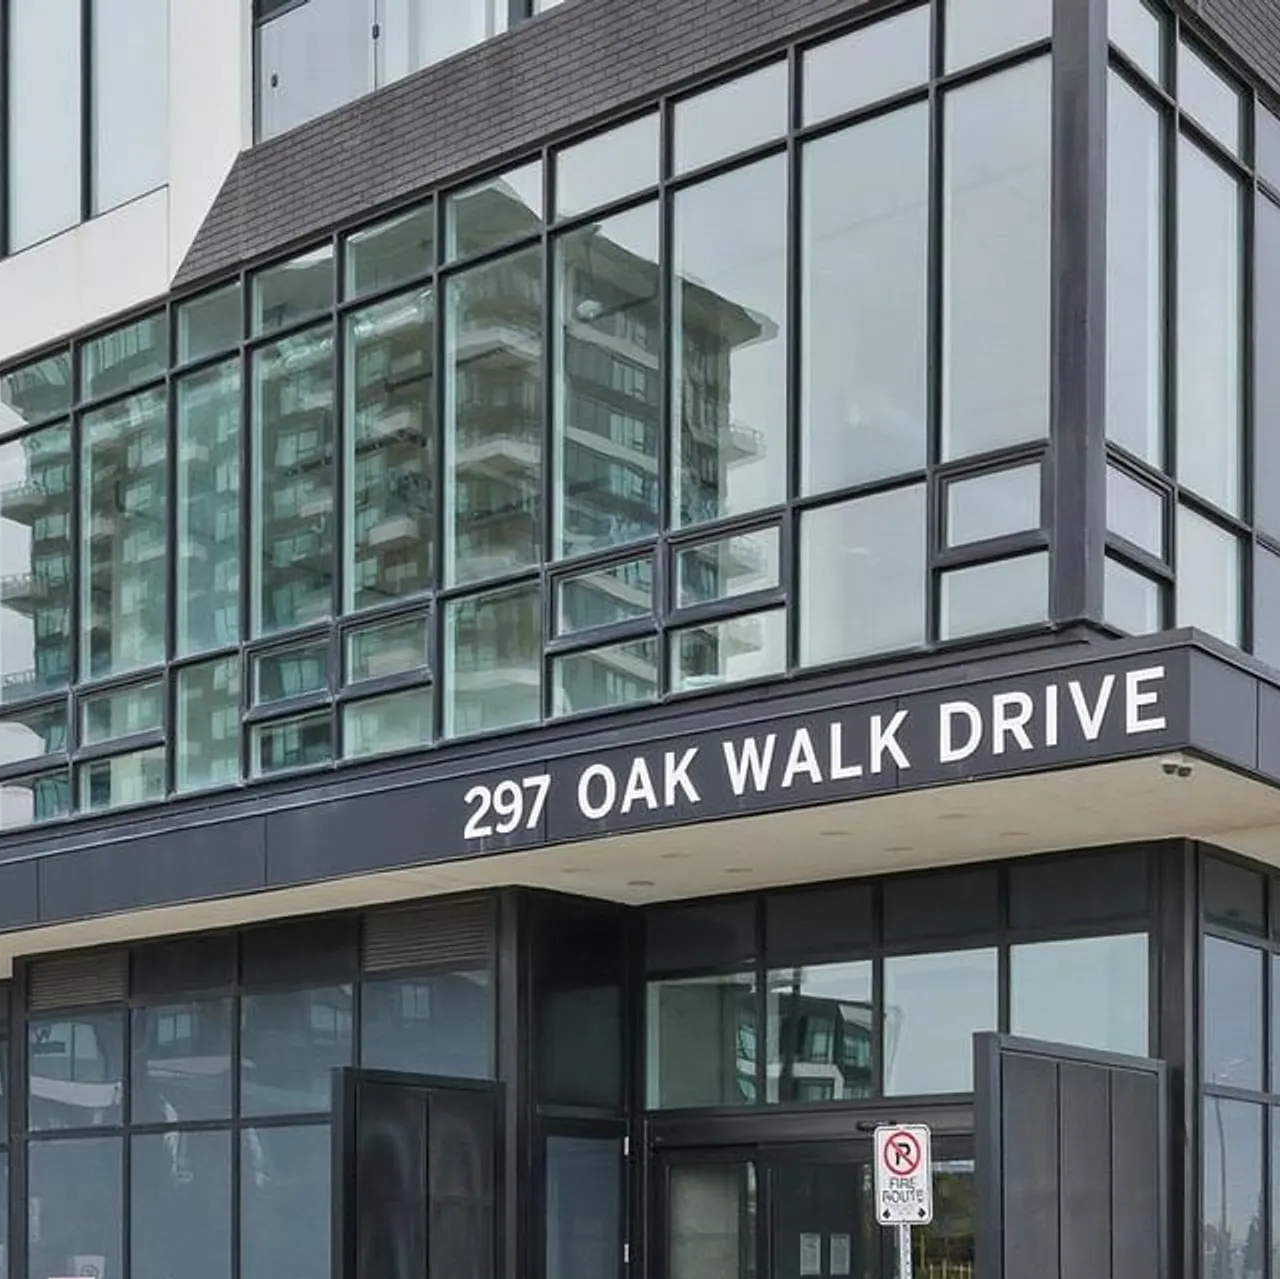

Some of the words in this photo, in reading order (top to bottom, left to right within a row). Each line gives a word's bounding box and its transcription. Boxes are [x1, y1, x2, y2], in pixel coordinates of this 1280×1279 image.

[464, 775, 551, 839] 297
[578, 747, 701, 819] OAK
[723, 710, 910, 795] WALK
[939, 666, 1168, 763] DRIVE
[889, 1177, 918, 1189] FIRE
[882, 1189, 925, 1203] ROUTE
